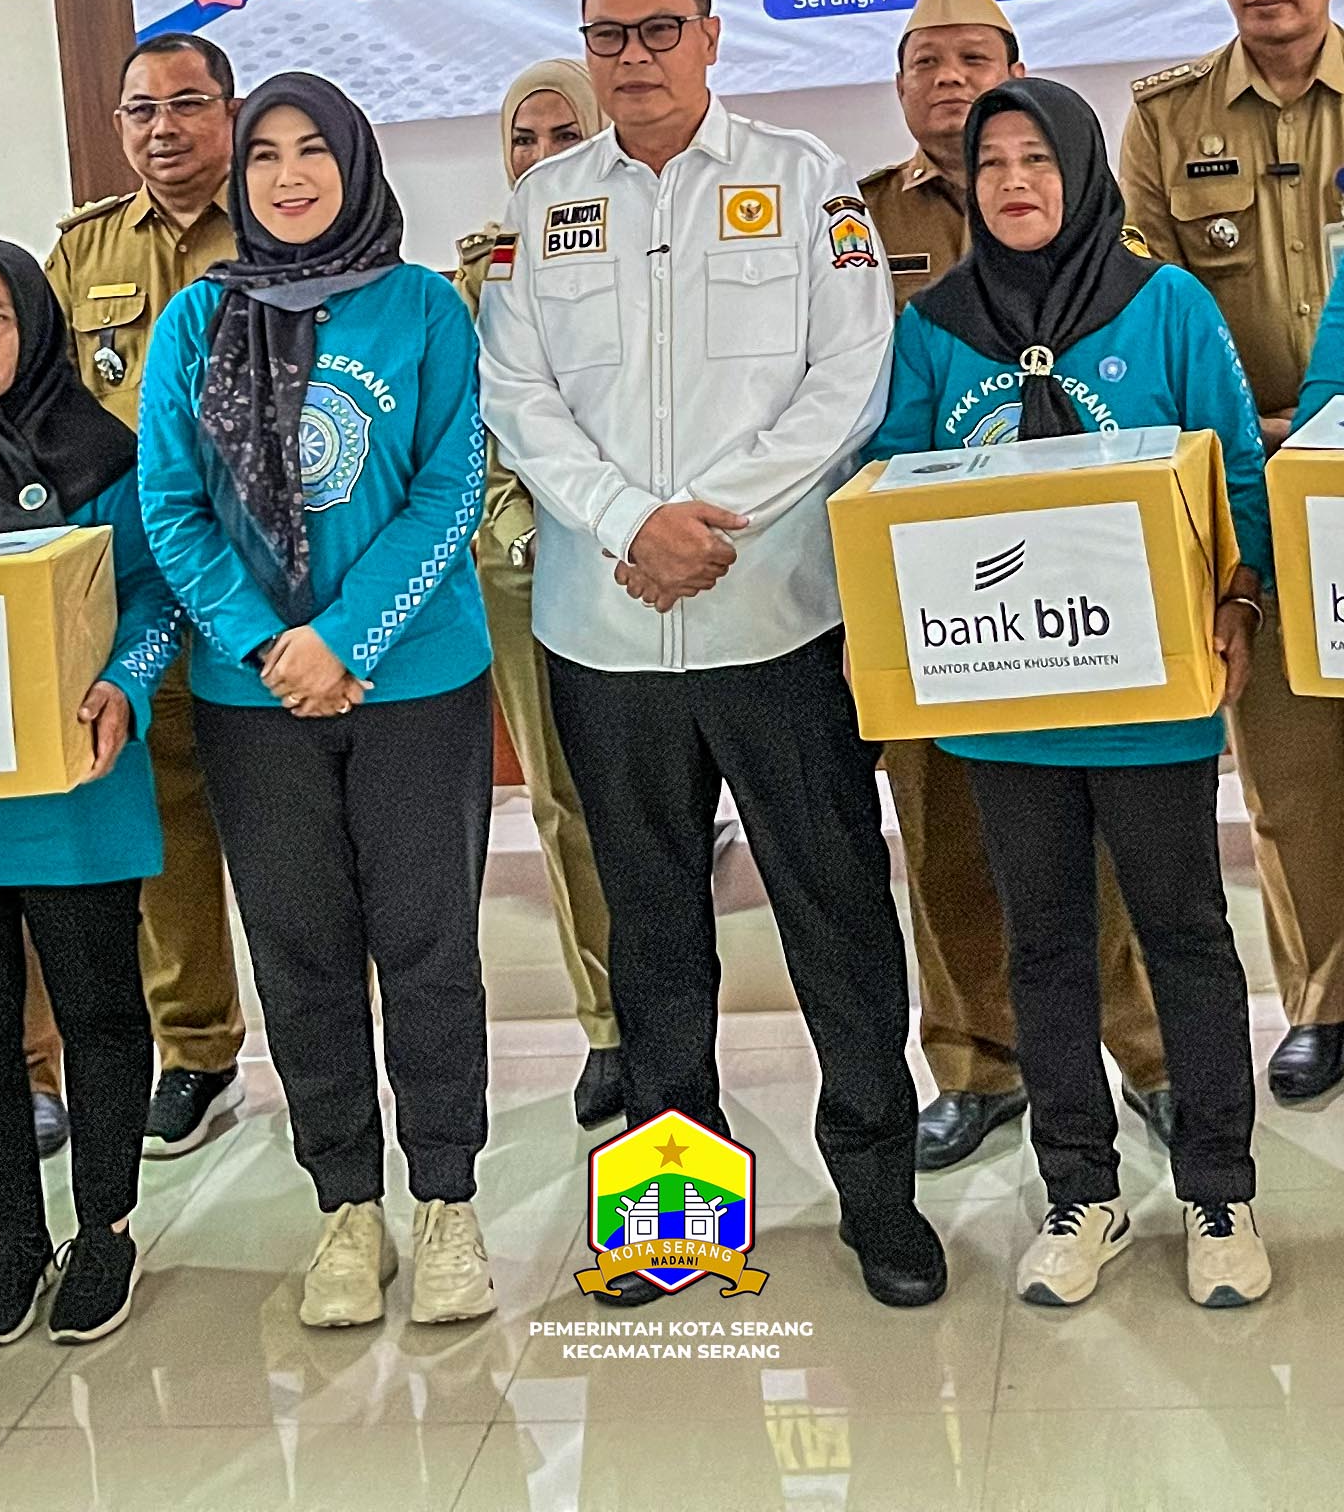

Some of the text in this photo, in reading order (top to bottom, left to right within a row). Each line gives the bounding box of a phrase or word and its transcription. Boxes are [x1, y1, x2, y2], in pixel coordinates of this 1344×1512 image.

[547, 228, 600, 252] BUDI
[316, 353, 396, 413] SERANG
[945, 389, 980, 434] PKK
[920, 596, 1111, 647] bank bjb
[923, 654, 1119, 676] KANTOR CABANG KHUSUS BANTEN
